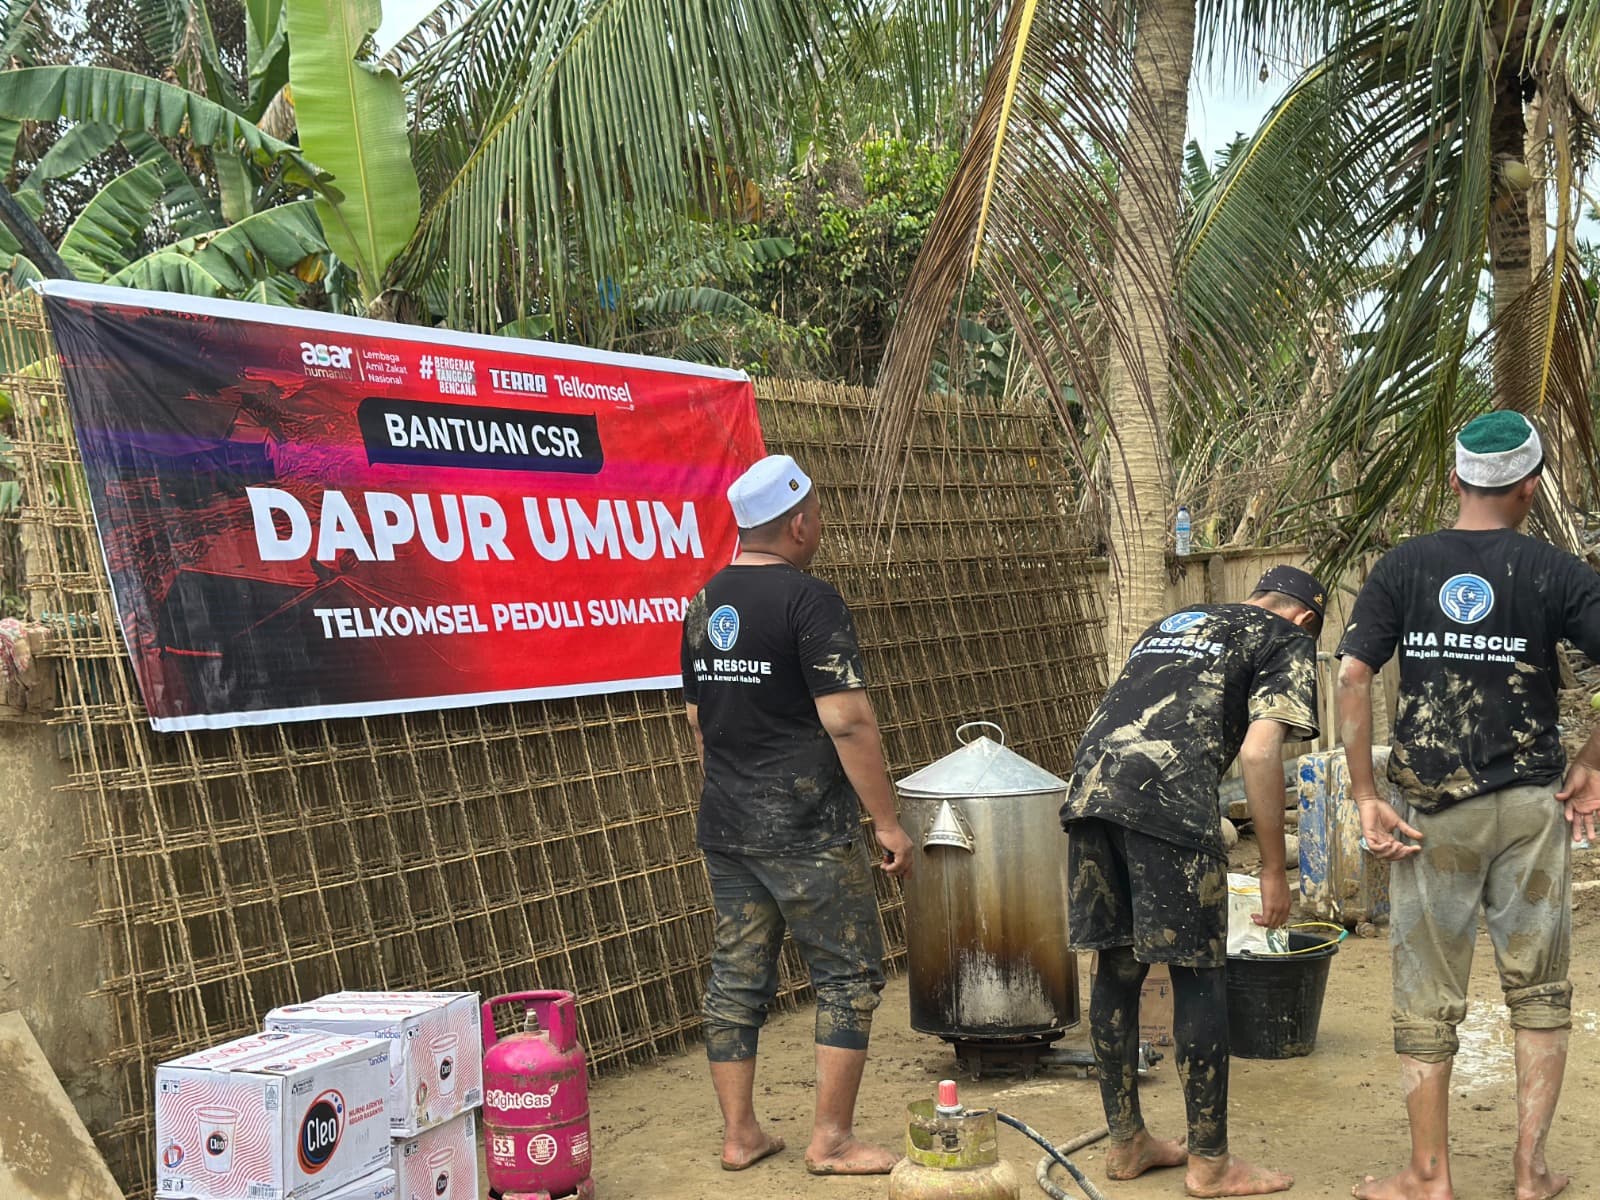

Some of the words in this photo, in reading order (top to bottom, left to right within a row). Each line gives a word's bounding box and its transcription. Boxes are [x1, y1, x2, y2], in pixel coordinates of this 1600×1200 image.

[300, 342, 352, 369] asar
[363, 350, 400, 363] Lembaga
[304, 365, 352, 382] humanity
[366, 362, 384, 372] Amil
[385, 363, 408, 375] Zakat
[436, 369, 473, 383] TANGGAP
[368, 374, 403, 385] Nasional
[439, 381, 477, 396] BENCANA
[488, 368, 547, 393] TERRA
[553, 374, 633, 402] Telkomsel
[384, 413, 528, 455] BANTUAN
[531, 427, 583, 458] CSR
[246, 487, 514, 561] DAPUR
[522, 496, 704, 561] UMUM
[314, 605, 488, 639] TELKOMSEL
[496, 601, 584, 632] PEDULI
[1147, 636, 1223, 656] RESCUE
[1444, 631, 1527, 652] RESCUE
[1443, 650, 1484, 661] Anwarul
[1487, 653, 1516, 663] Habib
[713, 658, 772, 675] RESCUE
[522, 1091, 551, 1109] Gas
[306, 1116, 337, 1152] Cleo
